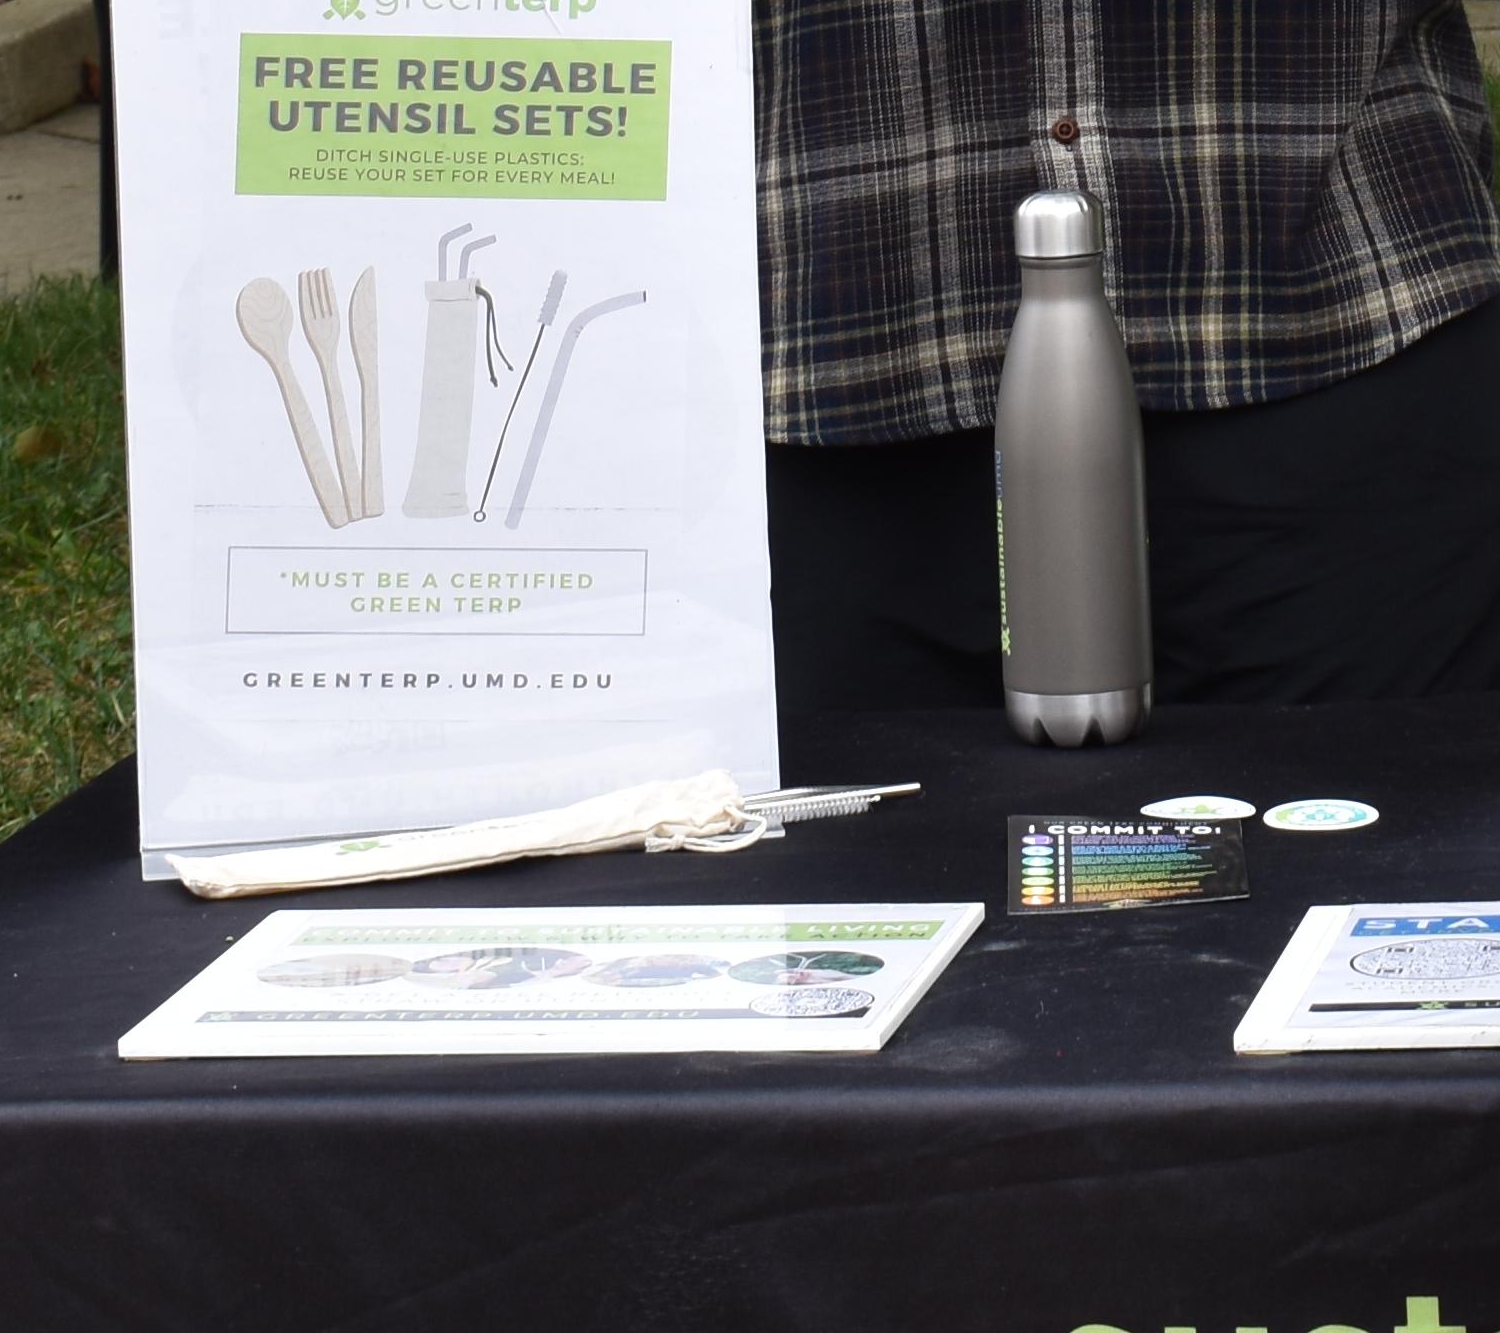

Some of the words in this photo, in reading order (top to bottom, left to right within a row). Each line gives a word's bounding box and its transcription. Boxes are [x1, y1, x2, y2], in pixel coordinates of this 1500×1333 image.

[255, 57, 379, 90] FREE
[397, 59, 657, 94] REUSABLE
[268, 100, 476, 134] UTENSIL
[493, 104, 628, 137] SETS!
[316, 149, 372, 163] DITCH
[378, 150, 488, 165] SINGLE-USE
[289, 166, 349, 181] REUSE
[355, 167, 406, 182] YOUR
[412, 168, 444, 182] SET
[451, 169, 489, 183] FOR
[495, 170, 554, 184] EVERY
[560, 171, 615, 185] MEAL!
[377, 572, 410, 588] BE
[422, 573, 438, 589] A
[451, 573, 594, 590] CERTIFIED
[351, 597, 442, 613] GREEN
[454, 597, 523, 613] TERP
[243, 672, 613, 689] GREENTERP.UMD.EDU
[1048, 825, 1162, 835] COMMIT
[1174, 825, 1221, 835] TO:
[806, 922, 932, 932] LIVING
